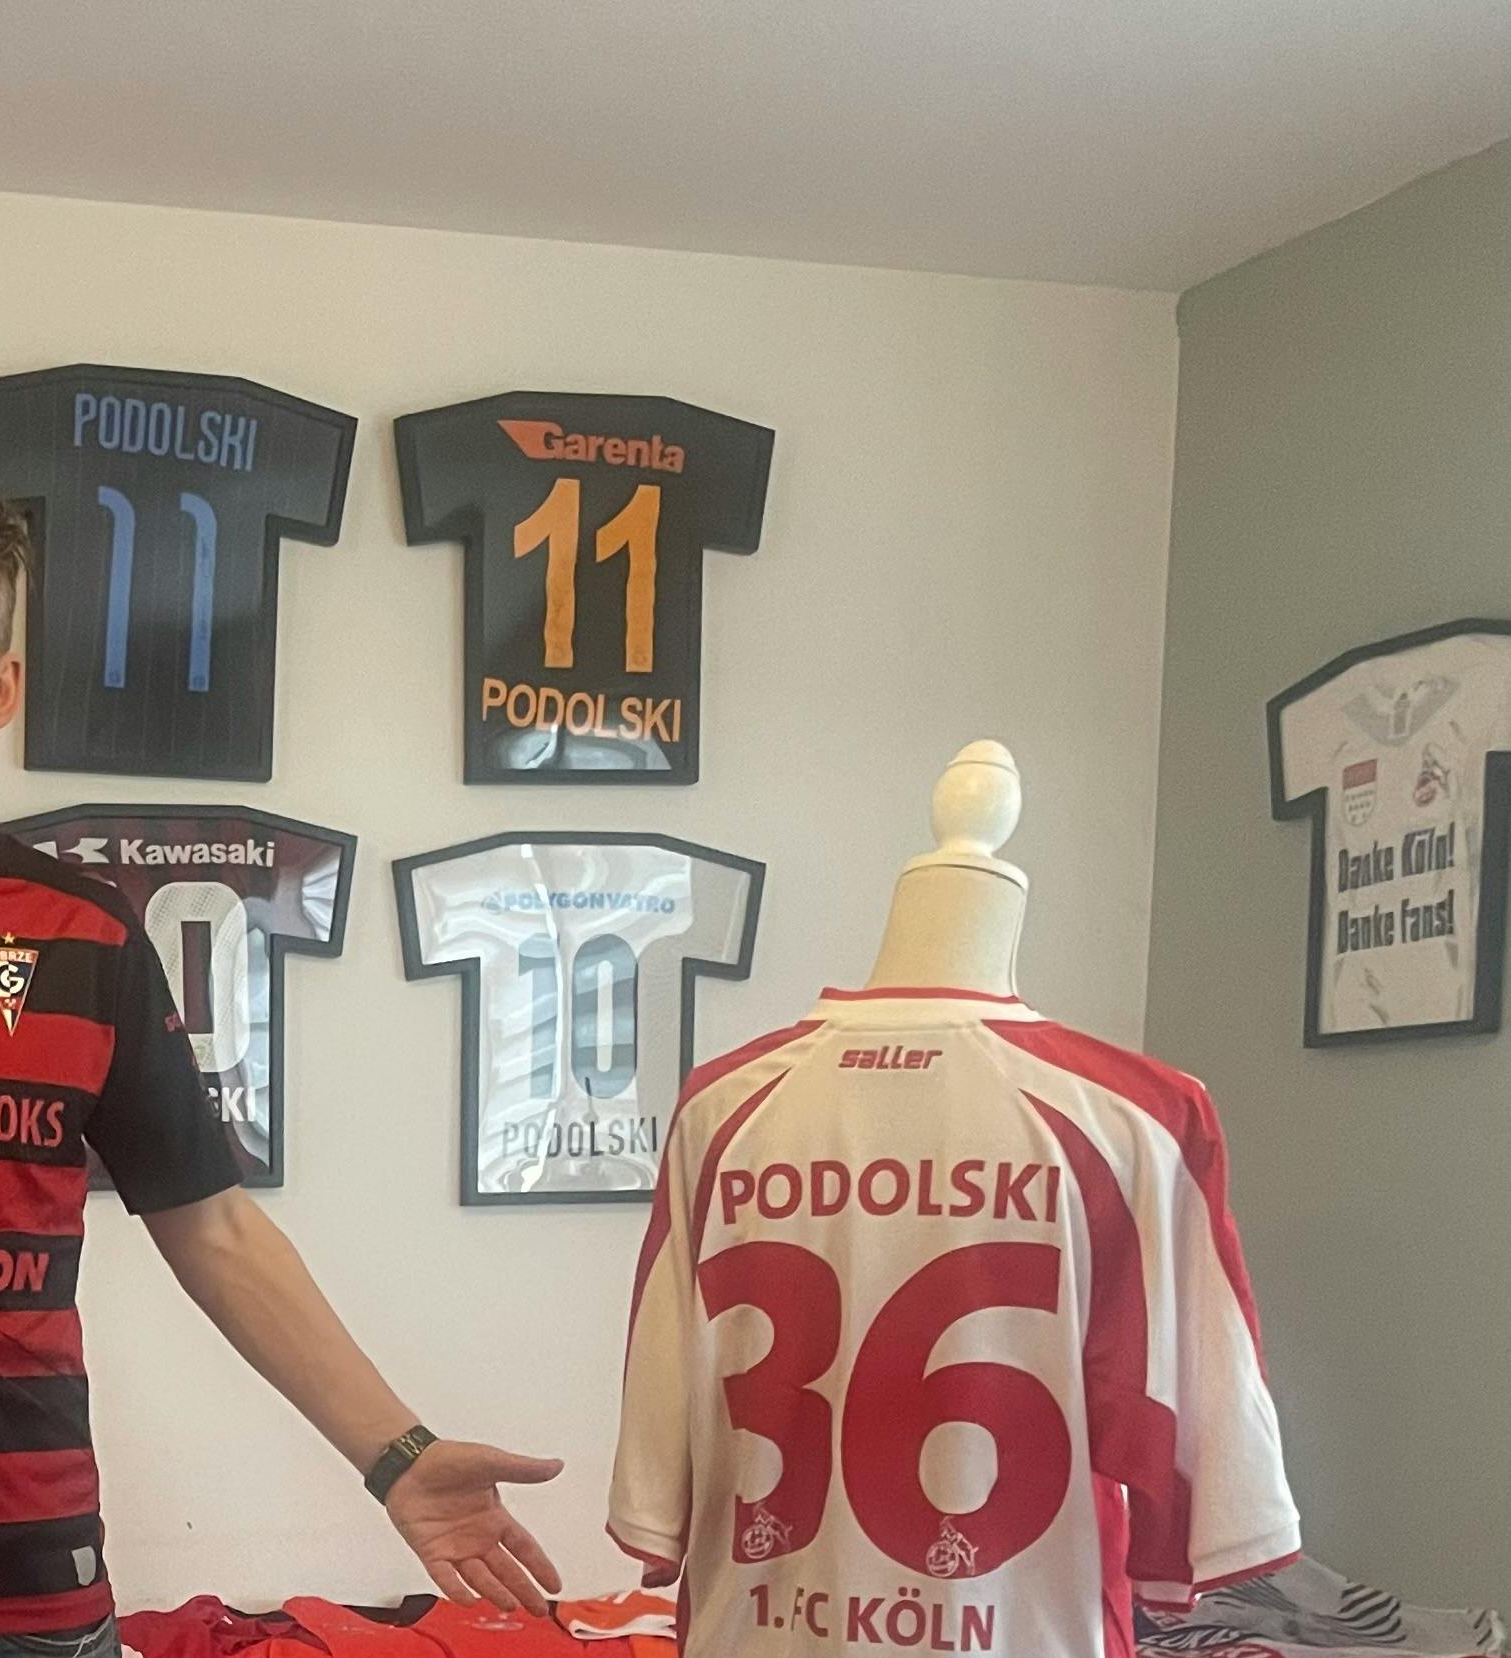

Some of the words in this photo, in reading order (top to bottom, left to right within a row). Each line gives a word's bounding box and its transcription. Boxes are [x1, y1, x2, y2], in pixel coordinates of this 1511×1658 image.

[73, 393, 258, 472] PODOLSKI
[539, 420, 686, 474] Garenta
[98, 486, 217, 692] 11
[513, 478, 661, 673] 11
[481, 677, 682, 743] PODOLSKI
[119, 838, 276, 868] Kawasaki
[1337, 840, 1395, 894] Danke
[1401, 821, 1456, 878] Köln!
[1336, 903, 1395, 955] Danke
[1400, 889, 1456, 943] Fans!
[517, 933, 638, 1099] 10
[838, 1045, 944, 1071] saller
[502, 1115, 659, 1158] PODOLSKI
[719, 1158, 1061, 1225] PODOLSKI
[697, 1240, 1072, 1580] 36
[846, 1586, 995, 1652] KÖLN
